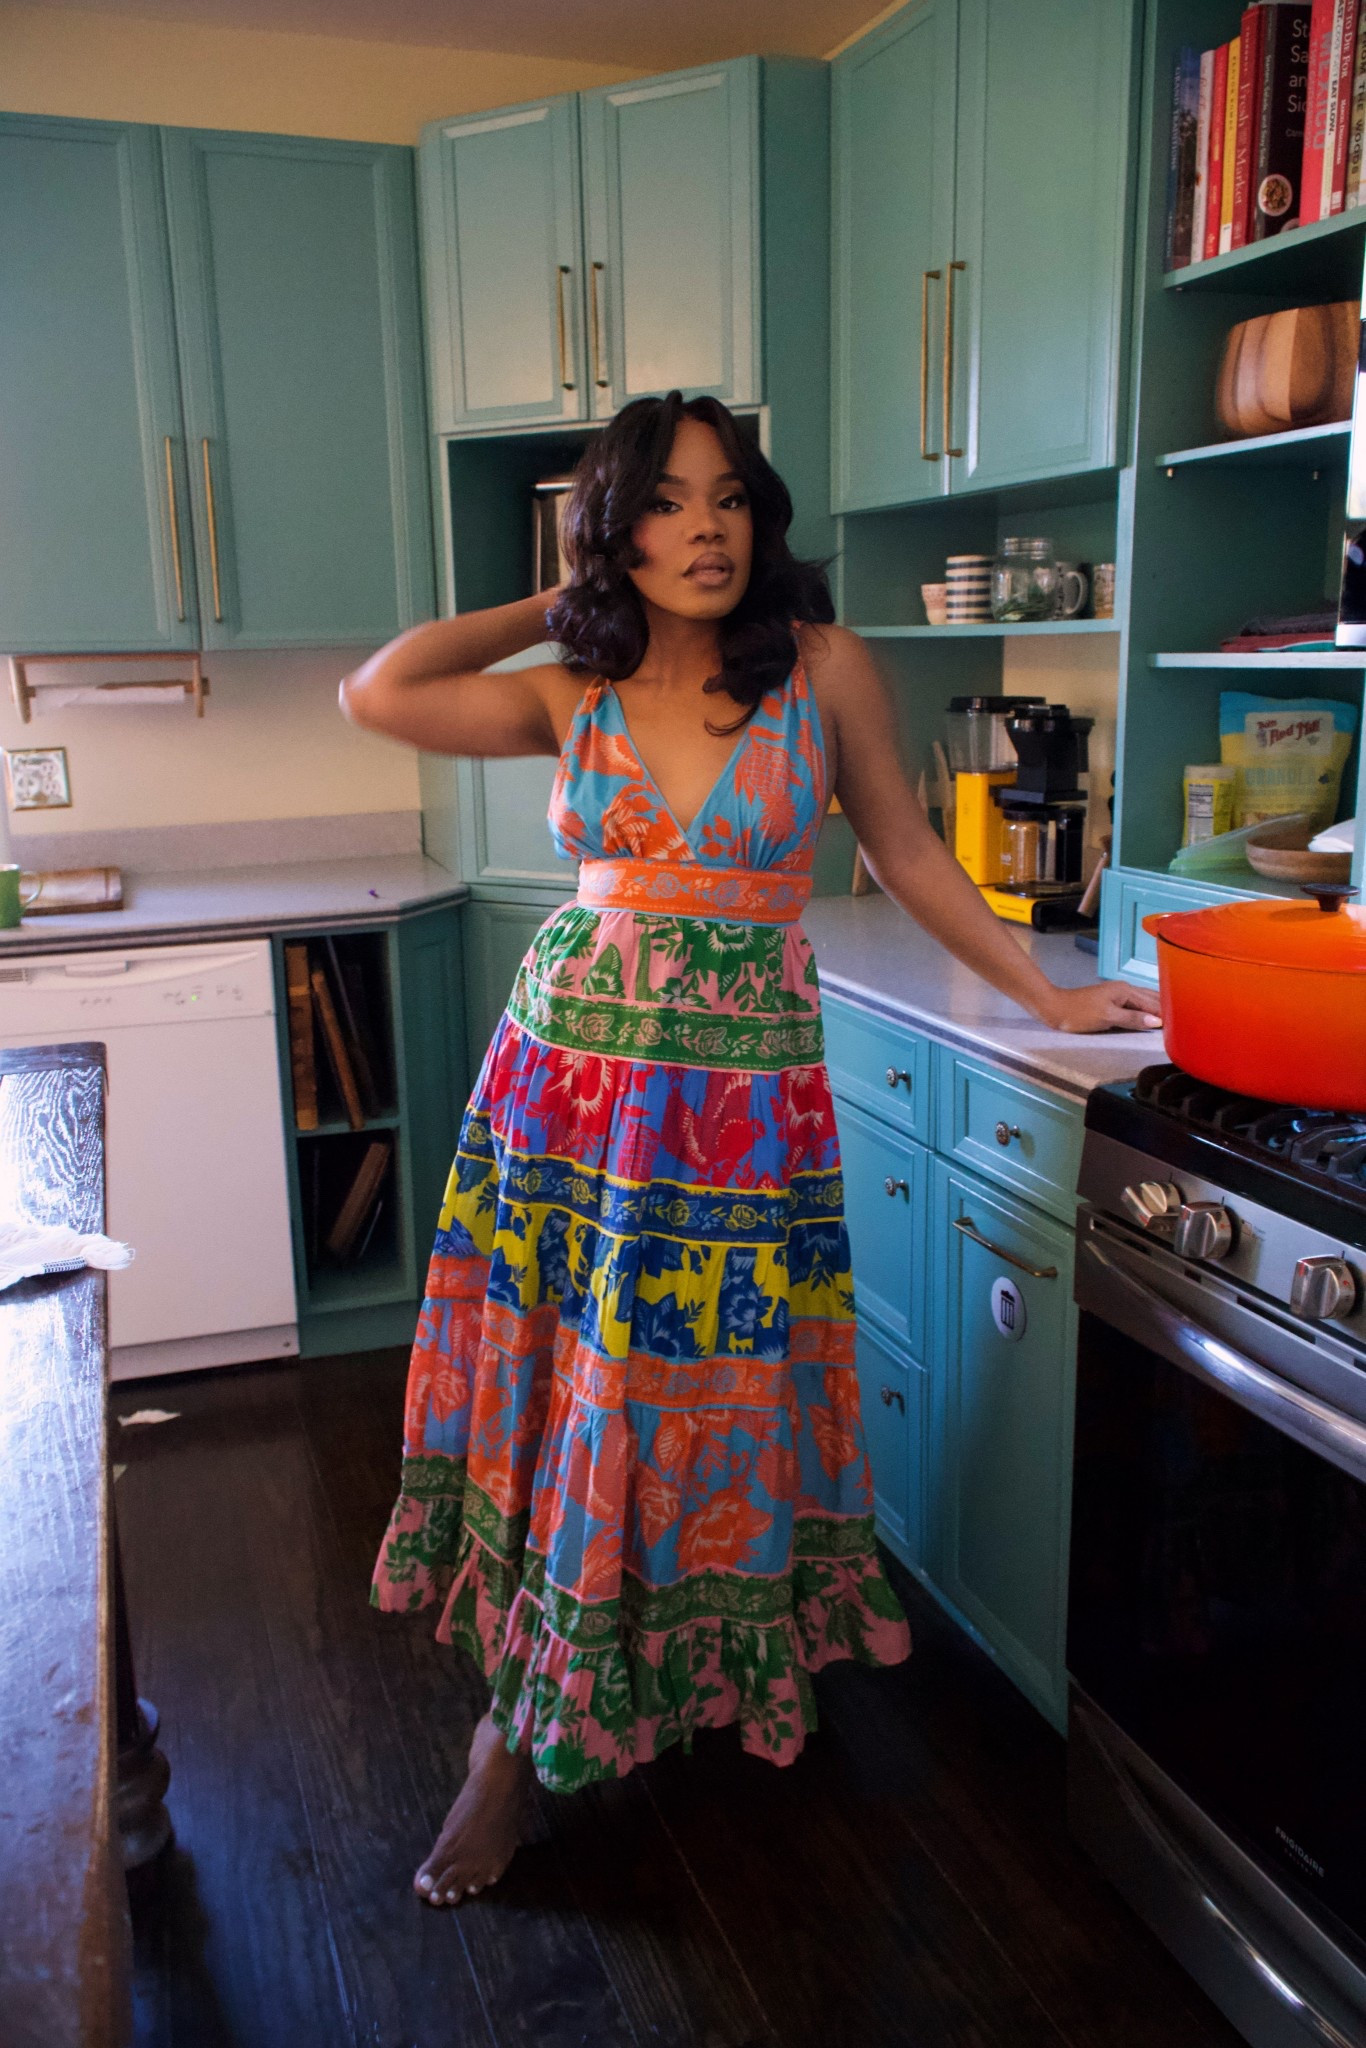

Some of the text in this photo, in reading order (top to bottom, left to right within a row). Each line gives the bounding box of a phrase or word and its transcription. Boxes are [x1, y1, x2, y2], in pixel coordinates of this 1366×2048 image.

[1344, 14, 1354, 30] TO
[1342, 32, 1353, 53] DIE
[1340, 55, 1351, 79] FOR
[1237, 82, 1250, 127] Fresh
[1355, 83, 1365, 109] THE
[1351, 121, 1363, 175] WOODS
[1234, 147, 1247, 205] Market
[1269, 724, 1294, 747] Red
[1296, 719, 1321, 741] Mill
[1275, 1825, 1325, 1878] FRIGIDAIRE
